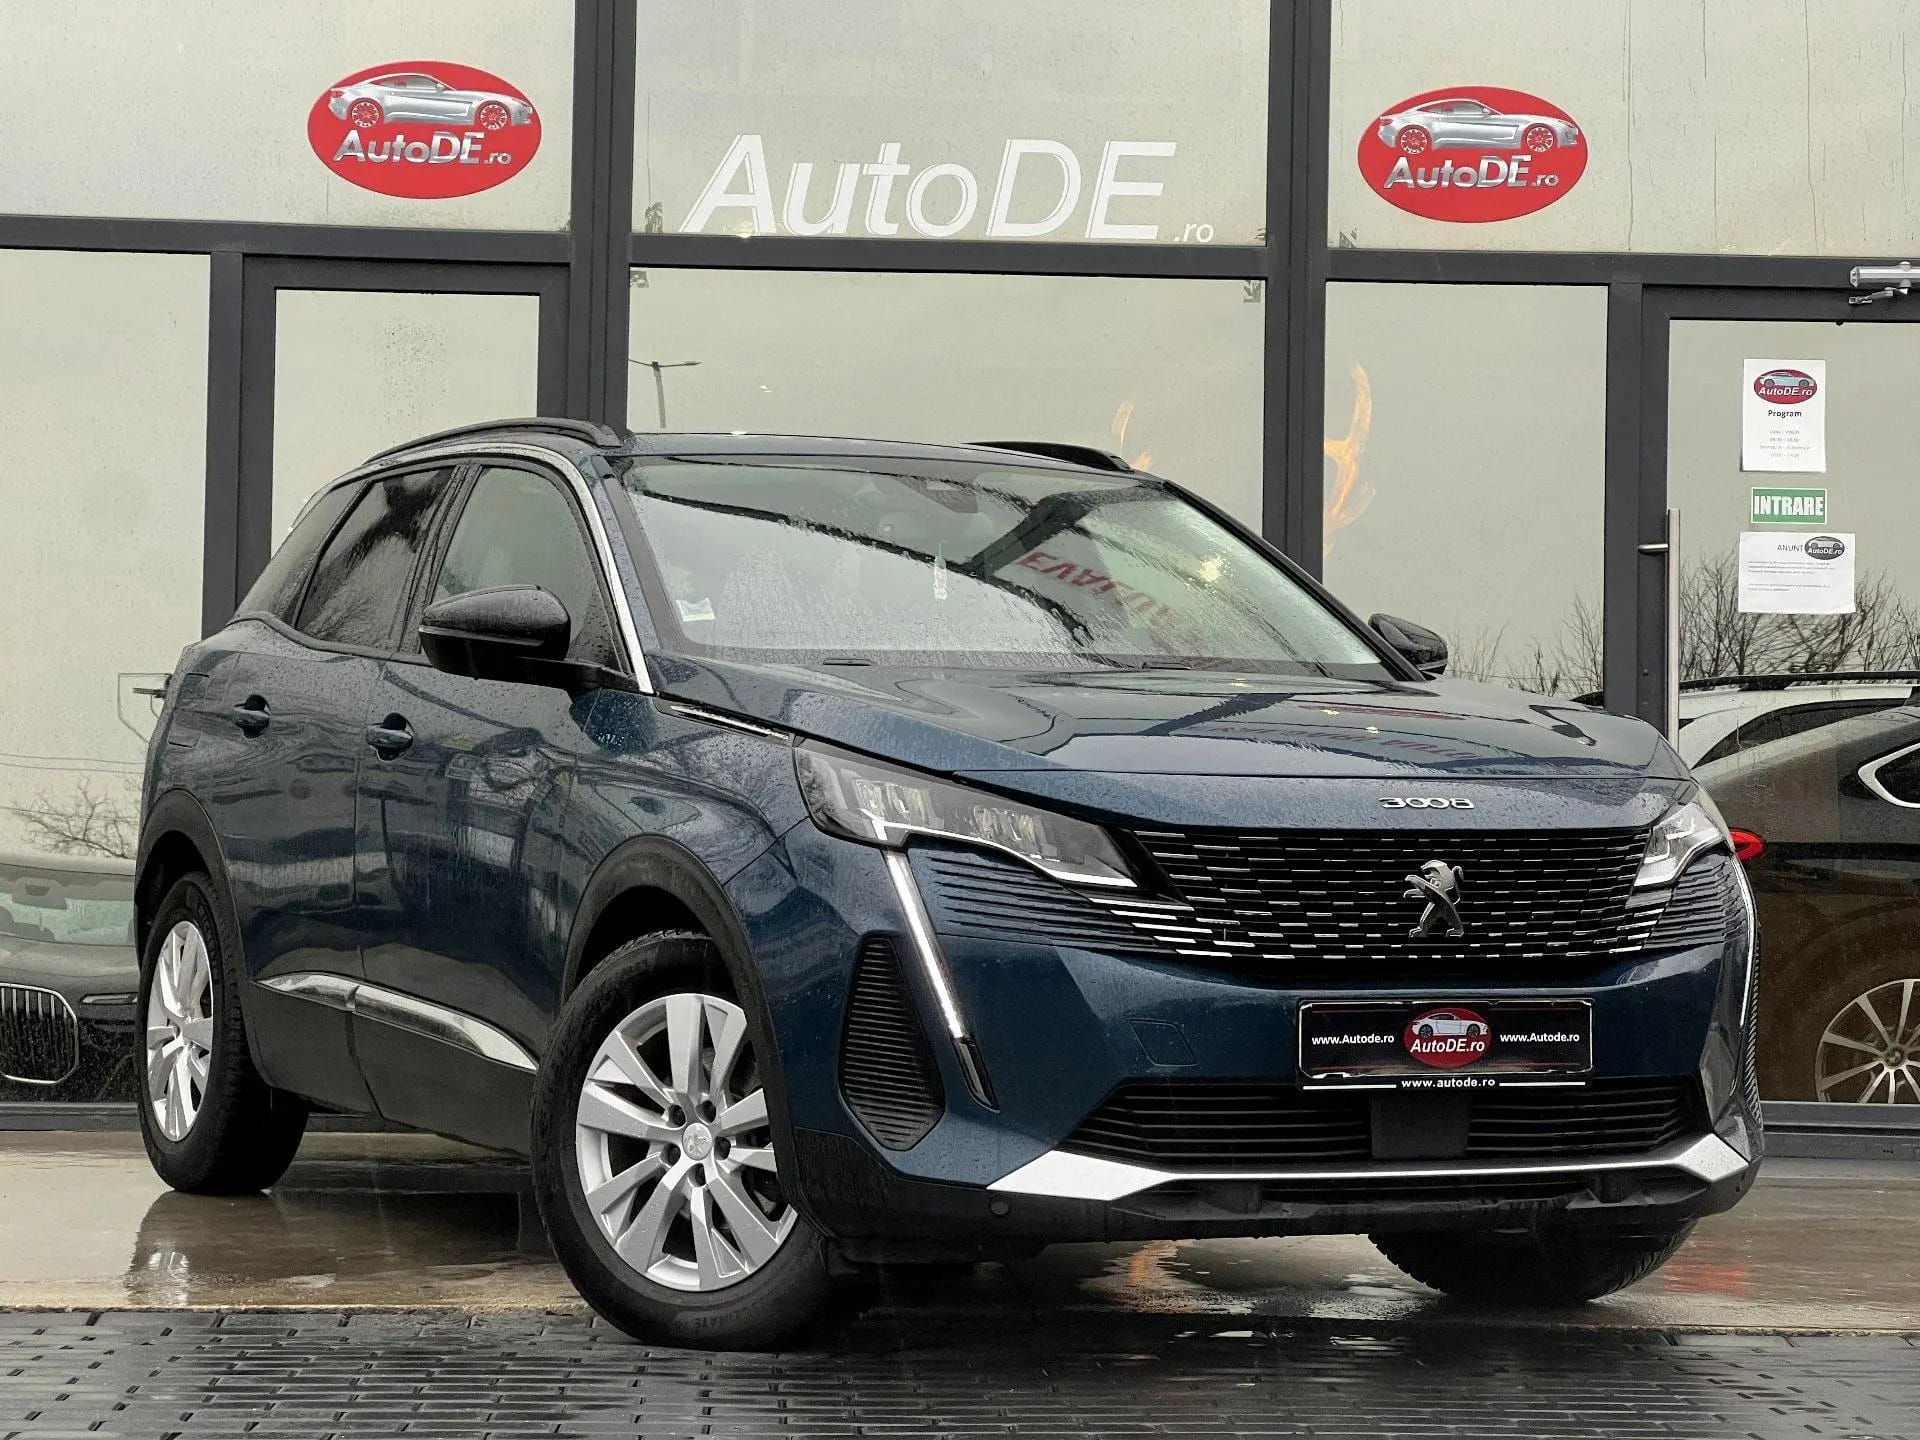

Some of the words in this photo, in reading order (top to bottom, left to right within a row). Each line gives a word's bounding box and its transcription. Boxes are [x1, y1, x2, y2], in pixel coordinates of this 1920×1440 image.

[1758, 386, 1813, 396] AutoDE.ro
[1768, 409, 1802, 418] Program
[1754, 495, 1824, 516] INTRARE
[1379, 797, 1475, 809] 3008
[1311, 1033, 1395, 1045] www.Autode.ro
[1500, 1032, 1580, 1043] www.Autode.ro
[1409, 1038, 1486, 1053] AutoDE.ro
[1401, 1077, 1496, 1088] www.autode.ro
